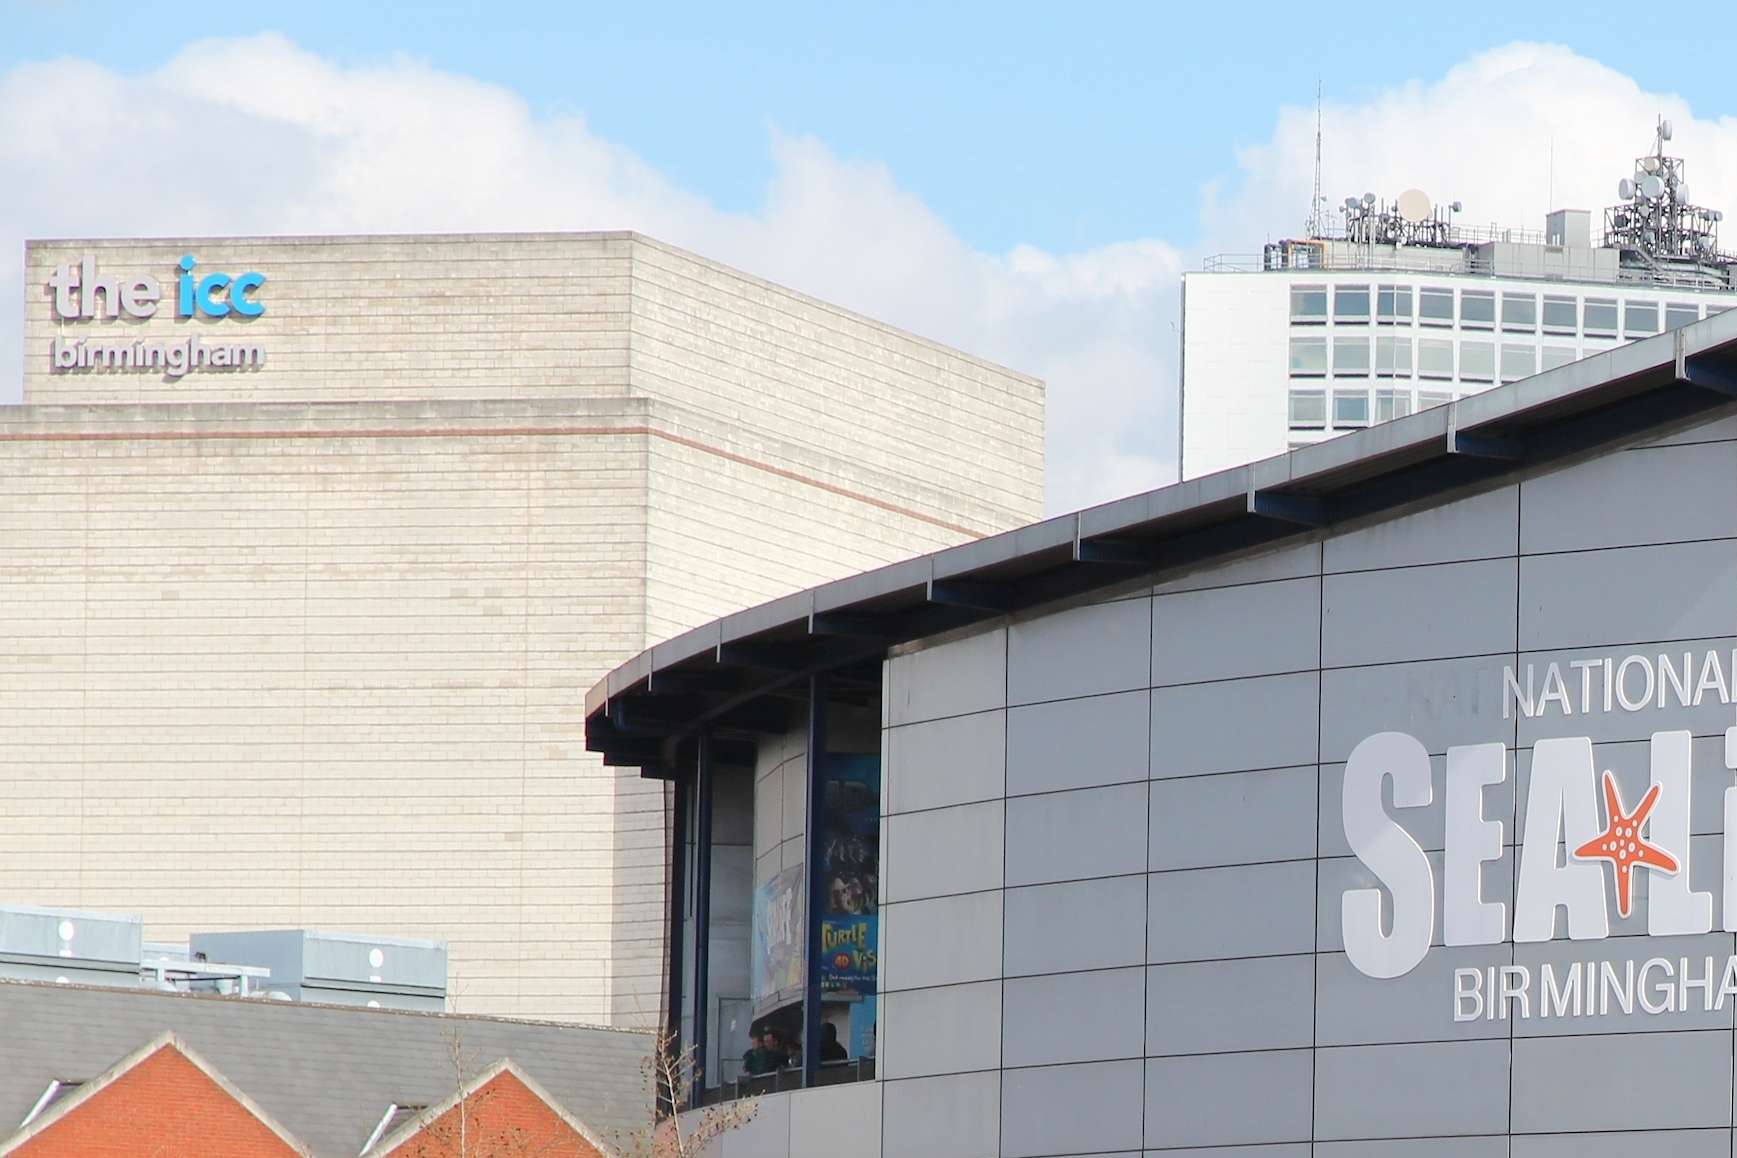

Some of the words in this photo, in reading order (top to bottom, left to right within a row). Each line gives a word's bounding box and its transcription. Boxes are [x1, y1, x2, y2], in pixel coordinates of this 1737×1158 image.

[49, 255, 161, 318] the
[179, 254, 266, 317] icc
[53, 335, 265, 376] birmingham
